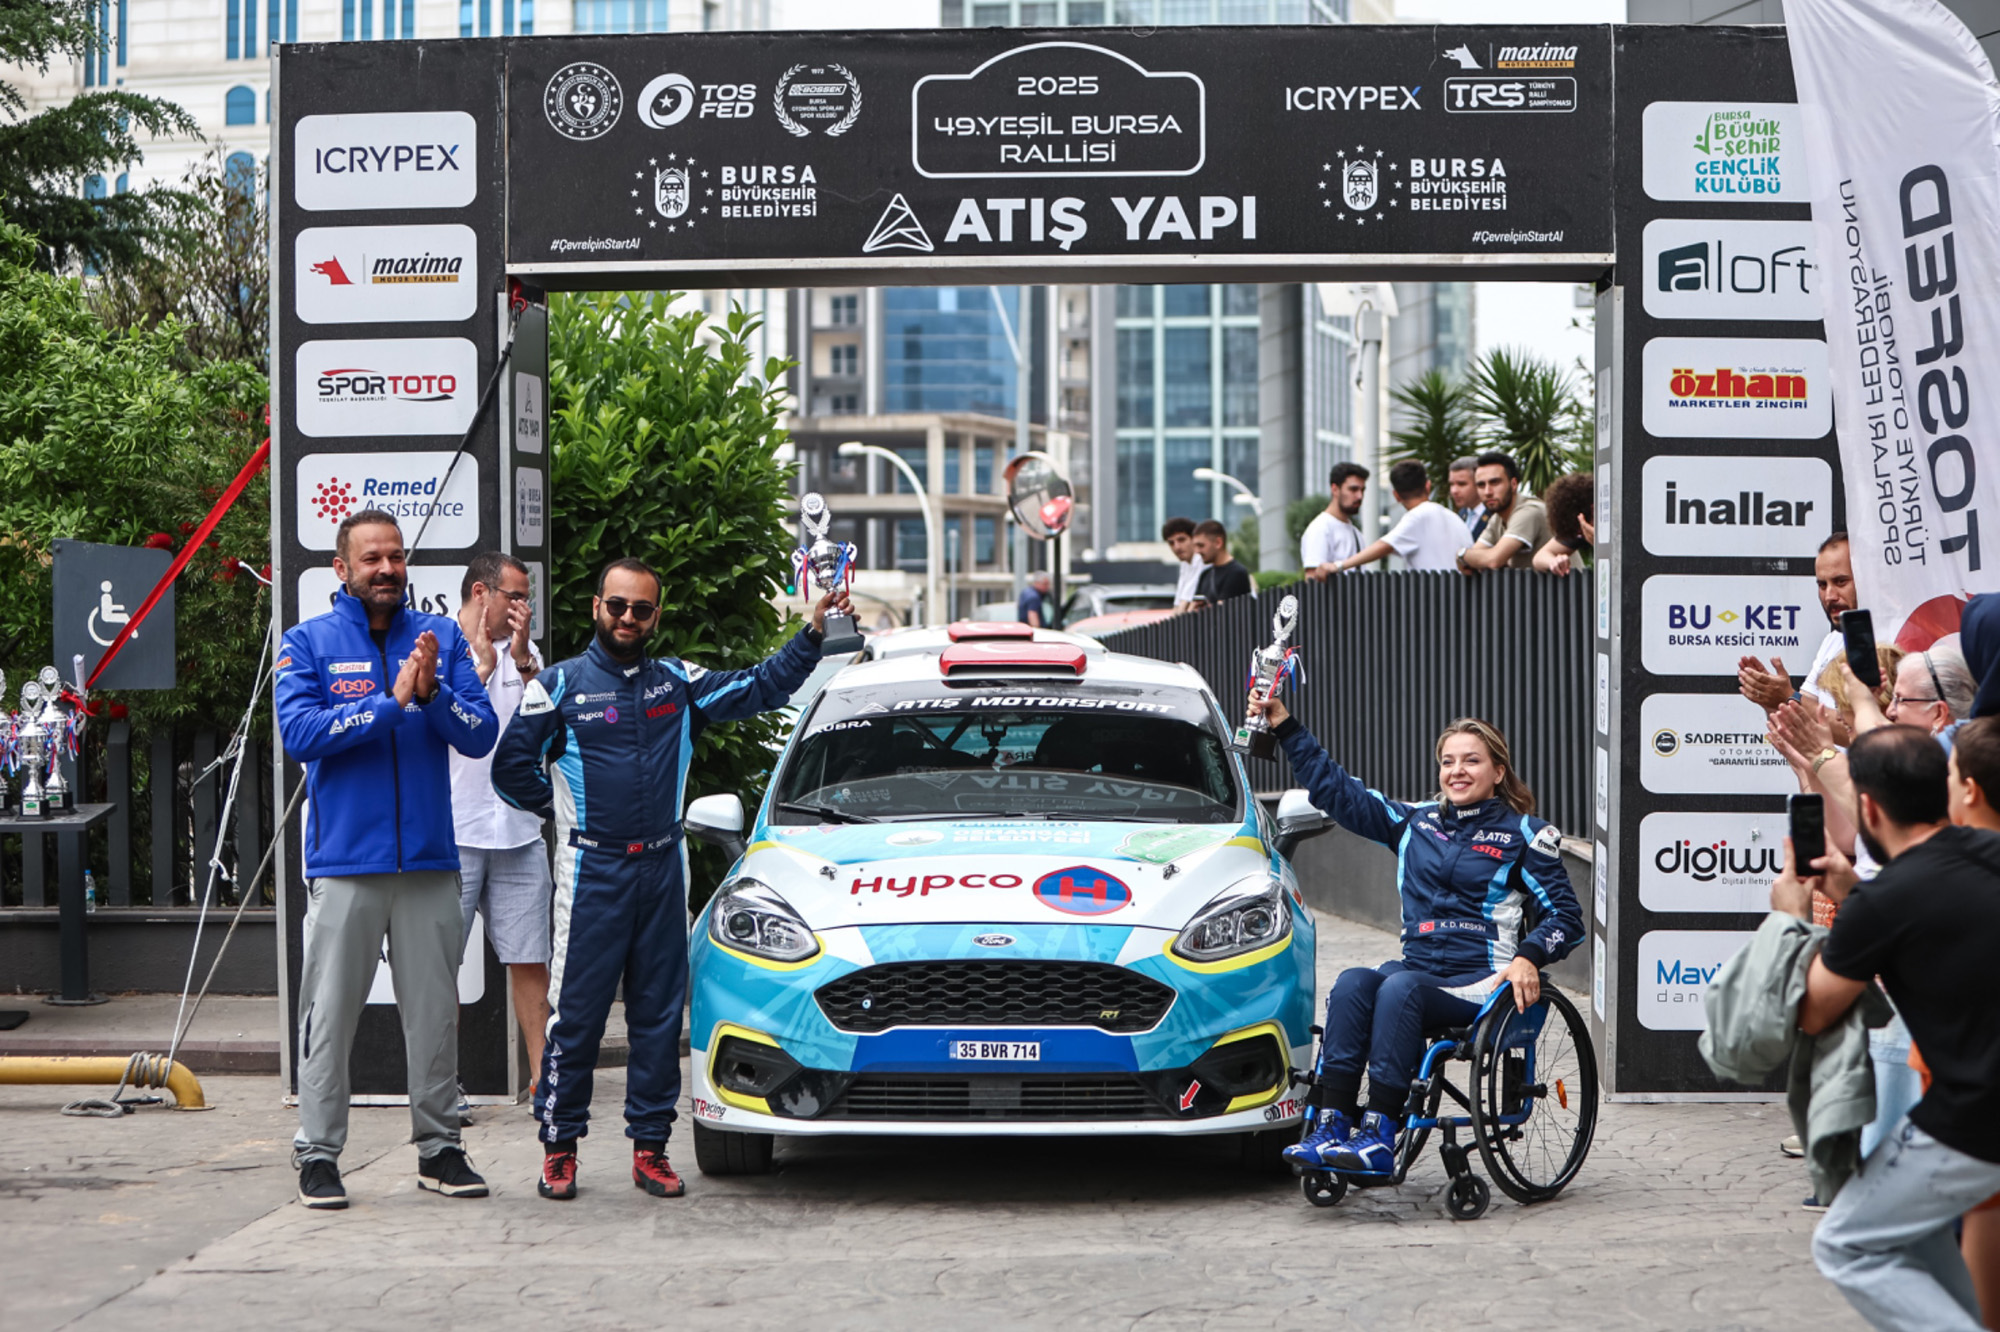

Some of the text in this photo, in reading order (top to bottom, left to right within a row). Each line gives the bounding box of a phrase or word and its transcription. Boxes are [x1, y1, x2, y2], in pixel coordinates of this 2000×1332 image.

[1499, 41, 1578, 62] maxima
[700, 84, 757, 101] TOS
[1018, 76, 1099, 95] 2025
[1448, 82, 1526, 107] TRS
[1286, 86, 1422, 111] ICRYPEX
[699, 102, 754, 119] FED
[934, 112, 1183, 139] 49.YEŞİL BURSA
[316, 144, 459, 174] ICRYPEX
[1000, 139, 1116, 163] RALLİSİ
[721, 165, 817, 184] BURSA
[1410, 158, 1507, 178] BURSA
[1695, 156, 1781, 176] GENÇLİK
[721, 184, 817, 202] BÜYÜKŞEHİR
[1410, 178, 1506, 196] BÜYÜKŞEHİR
[1695, 177, 1781, 194] KULÜBÜ
[721, 202, 817, 218] BELEDİYESİ
[1410, 196, 1507, 211] BELEDİYESİ
[943, 195, 1256, 252] ATIŞ YAPI
[372, 252, 463, 275] maxima
[1658, 240, 1812, 294] aloft
[413, 275, 451, 283] YAĞLARI
[1670, 368, 1807, 399] özhan
[1669, 399, 1807, 409] MARKETLER ZİNCİRİ
[363, 477, 437, 496] Remed
[1669, 632, 1799, 647] BURSA KESİCİ TAKIM
[646, 702, 678, 719] VESTEL
[971, 697, 1176, 714] MOTORSPORT
[578, 711, 604, 722] Hypco
[850, 874, 1023, 898] Hypco
[1722, 877, 1746, 885] Dijital
[974, 934, 1013, 946] Ford
[1657, 959, 1722, 984] Mav
[1657, 989, 1699, 1003] dan
[960, 1043, 1038, 1059] 35 BVR 714
